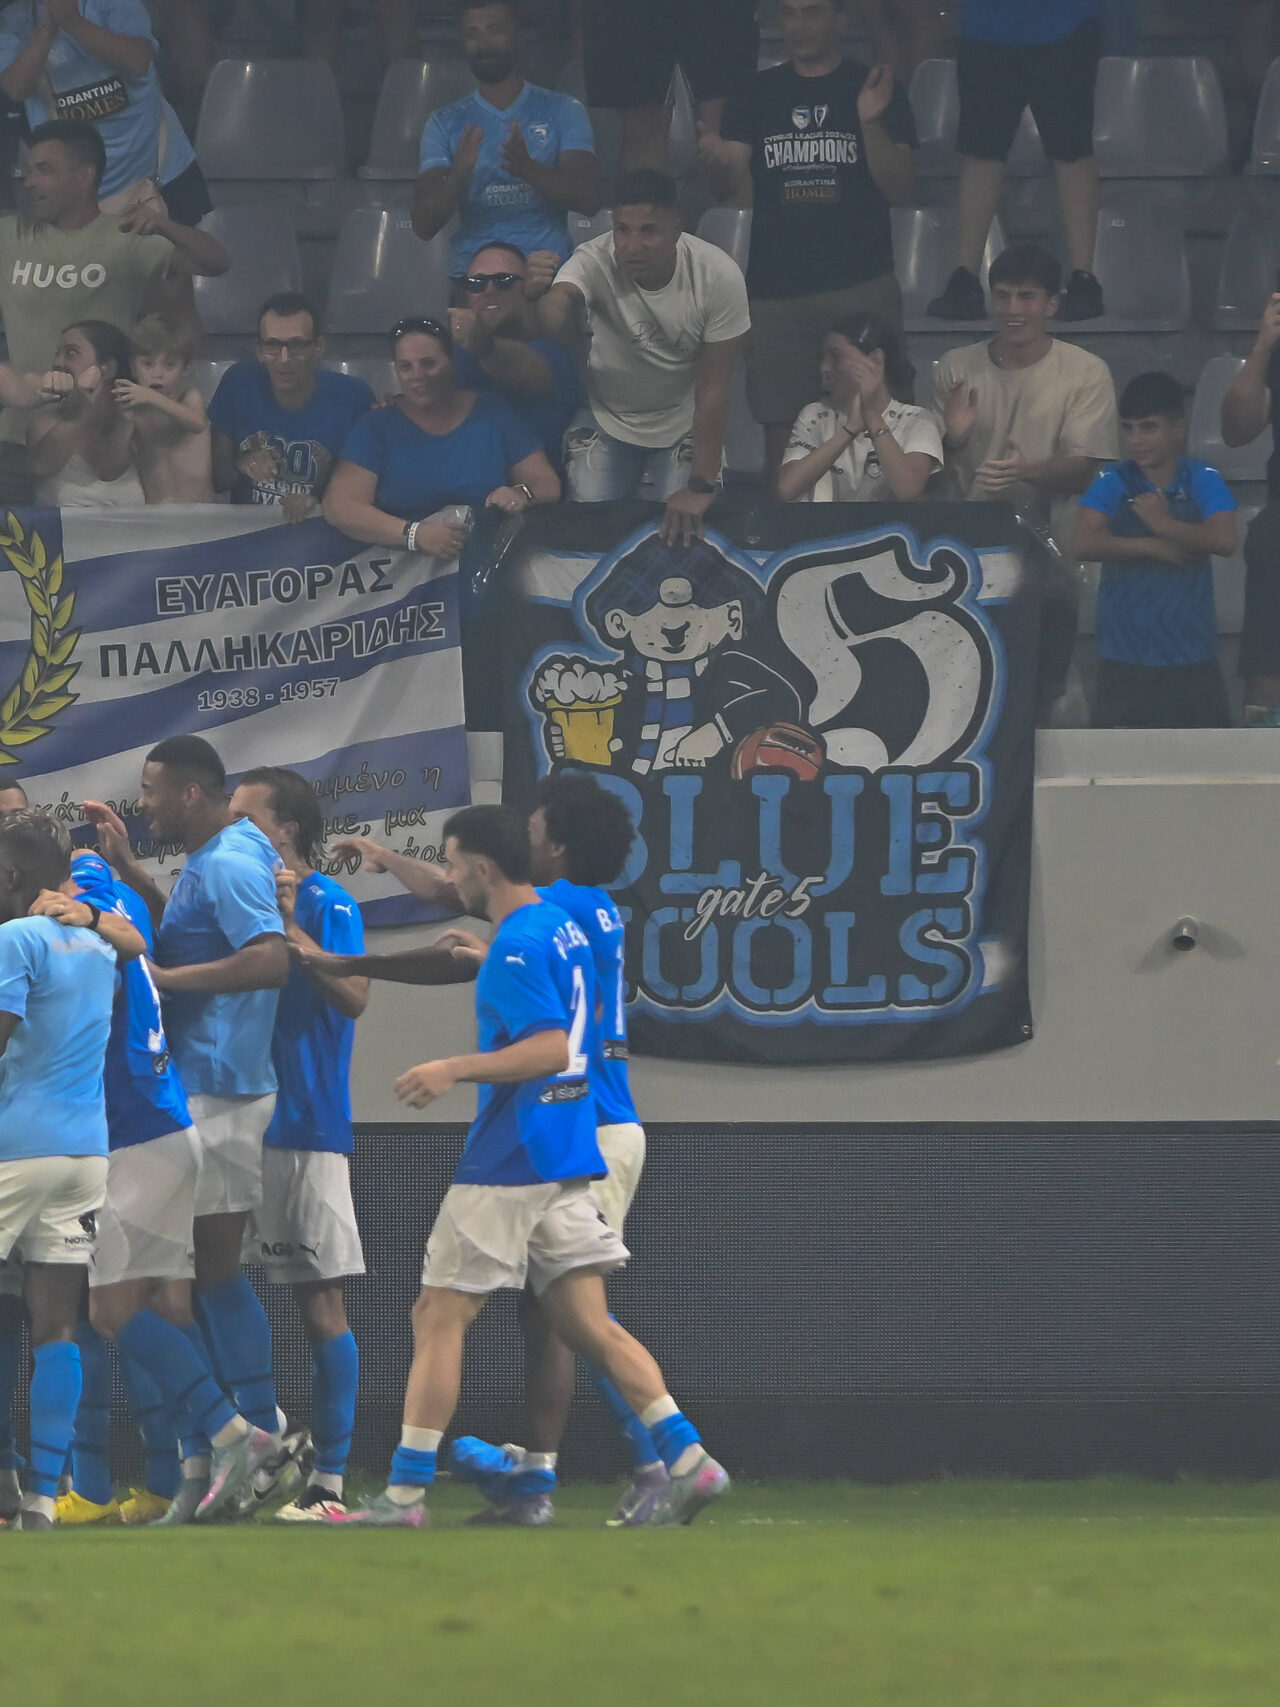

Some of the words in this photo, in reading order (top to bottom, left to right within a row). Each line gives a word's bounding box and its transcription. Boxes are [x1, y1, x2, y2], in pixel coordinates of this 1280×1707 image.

[57, 80, 122, 108] ORANTINA
[764, 138, 858, 169] CHAMPIONS
[12, 259, 107, 289] HUGO
[156, 558, 394, 615] ΕΥΑΓΟΡΑΣ
[99, 600, 446, 679] ΠΑΛΛΗΚΑΡΙΔΗΣ
[198, 687, 260, 711] 1938
[280, 677, 341, 703] 1957
[618, 906, 967, 1003] OOLS
